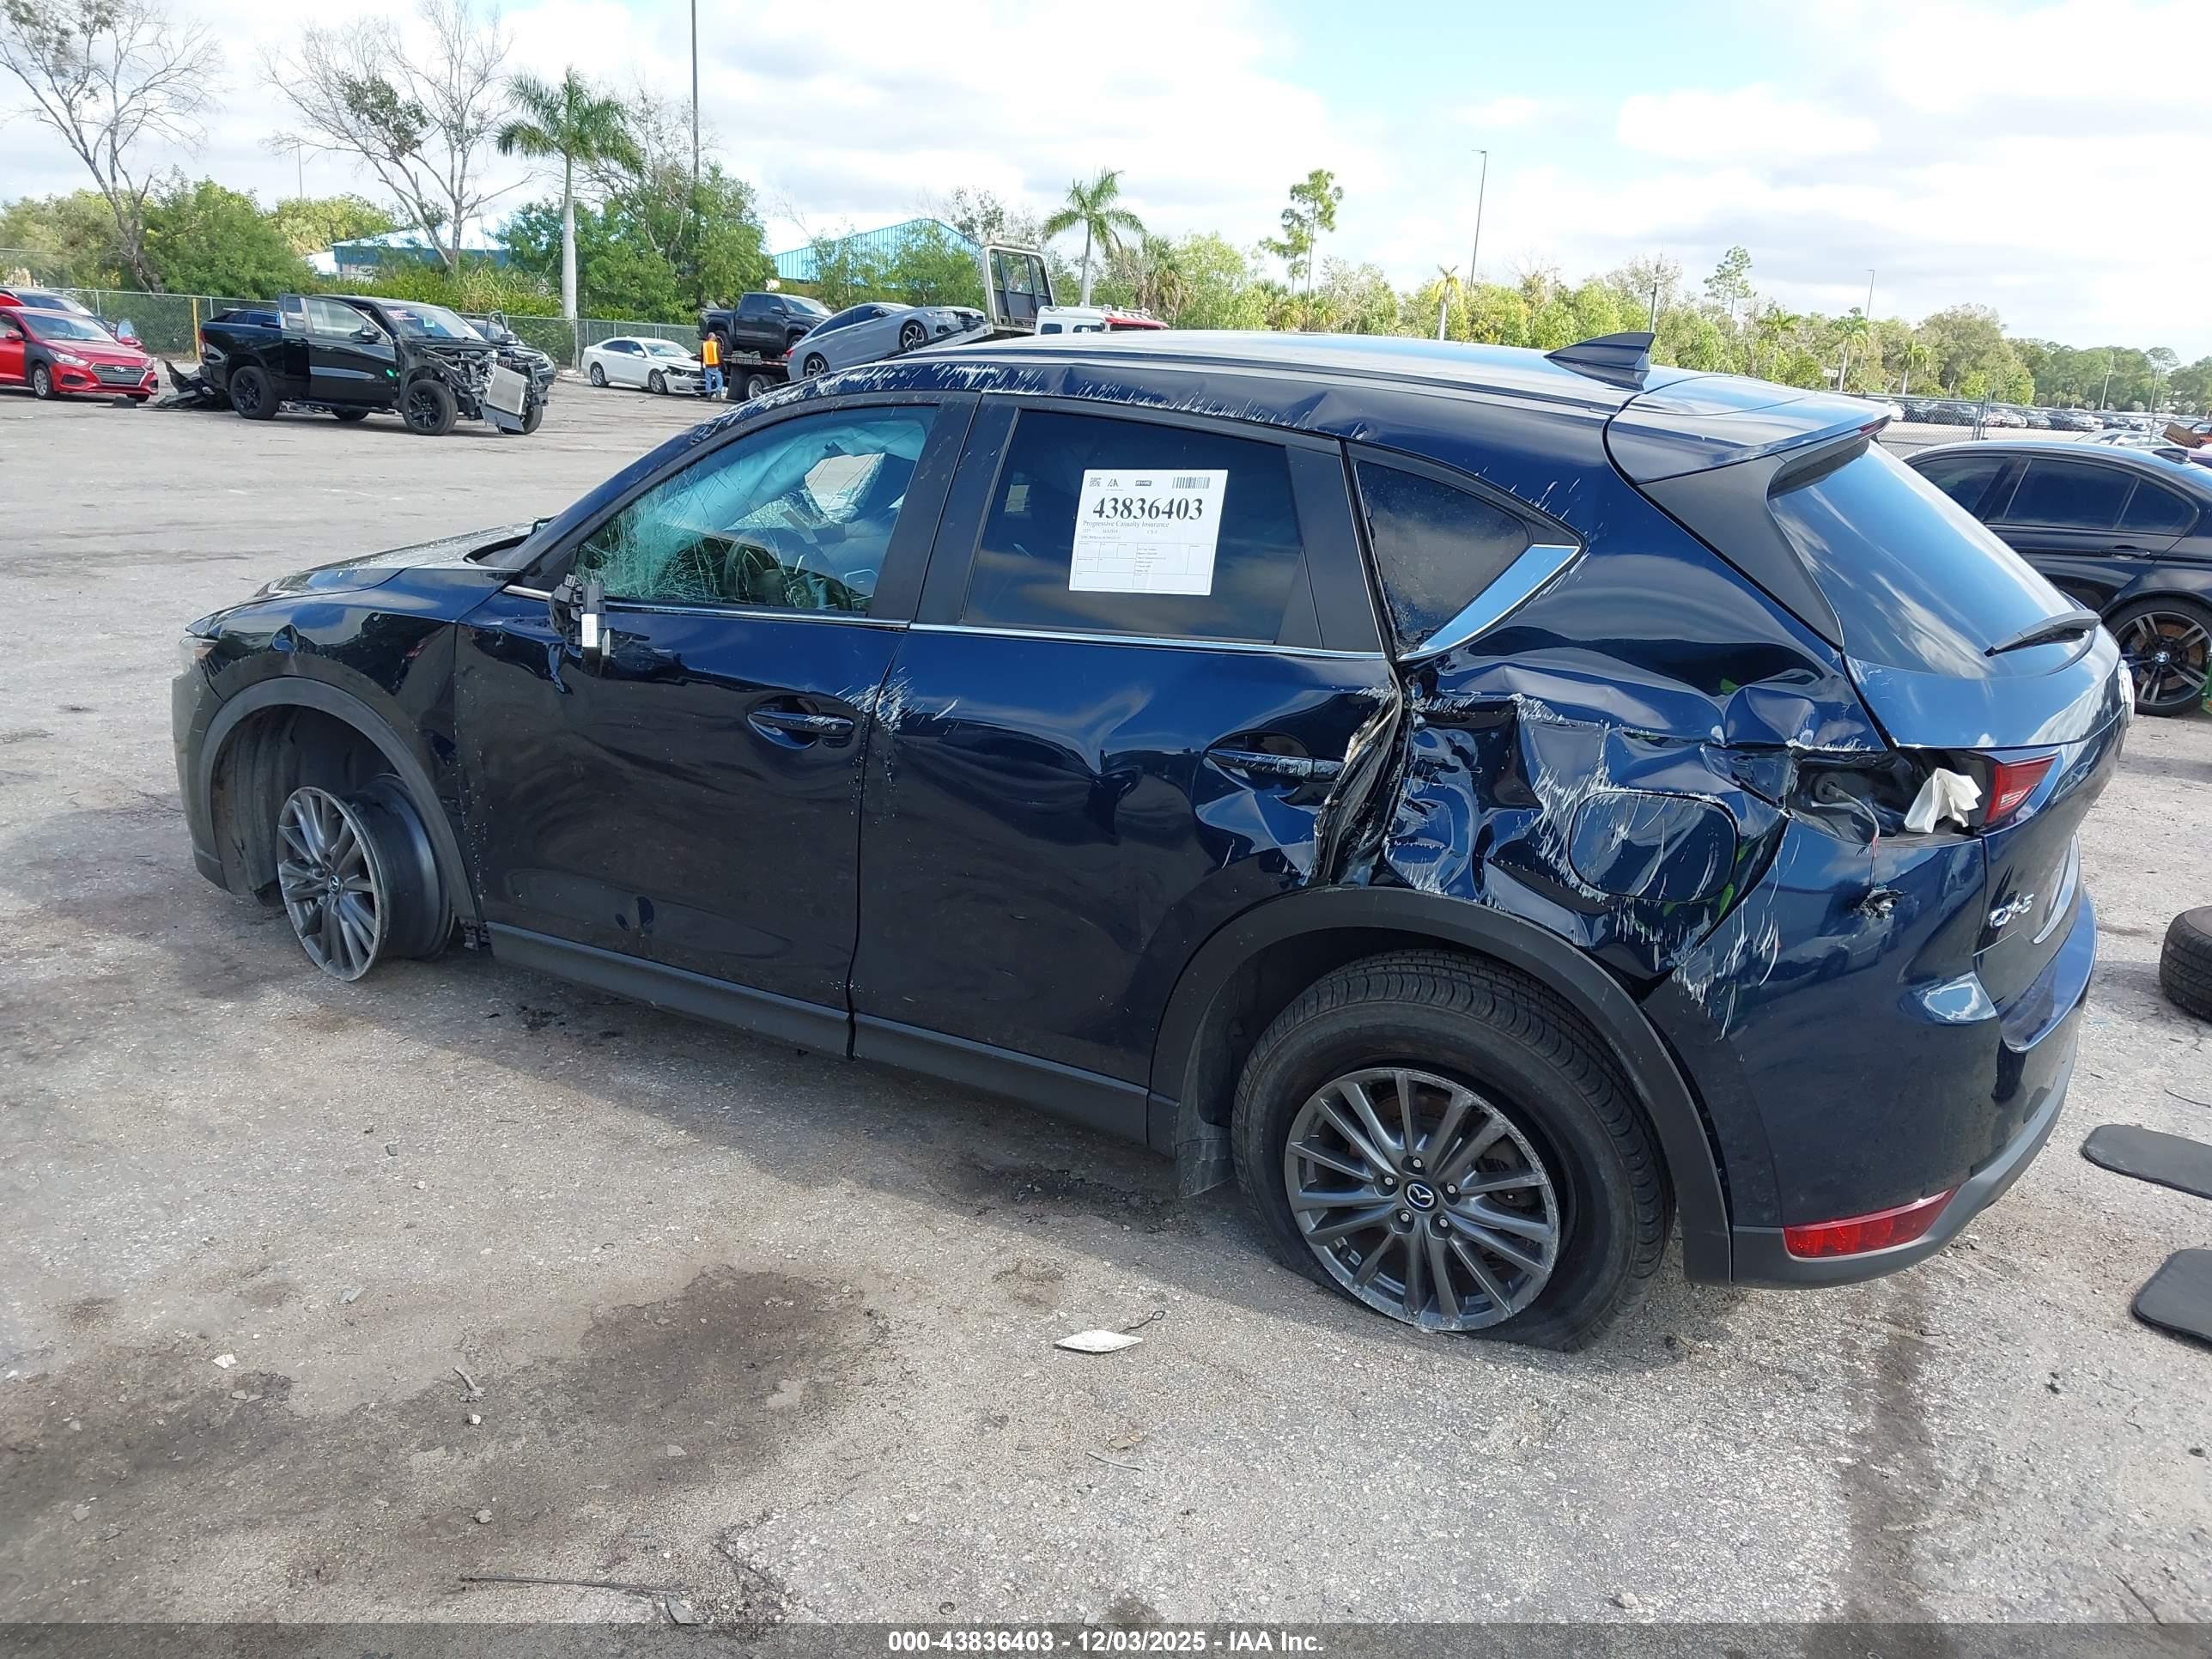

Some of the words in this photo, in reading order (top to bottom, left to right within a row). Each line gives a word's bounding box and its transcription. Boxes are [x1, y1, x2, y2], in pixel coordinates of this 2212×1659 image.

[1092, 497, 1203, 520] 43836403
[1083, 520, 1115, 529] Progressive
[1115, 520, 1140, 529] Casualty
